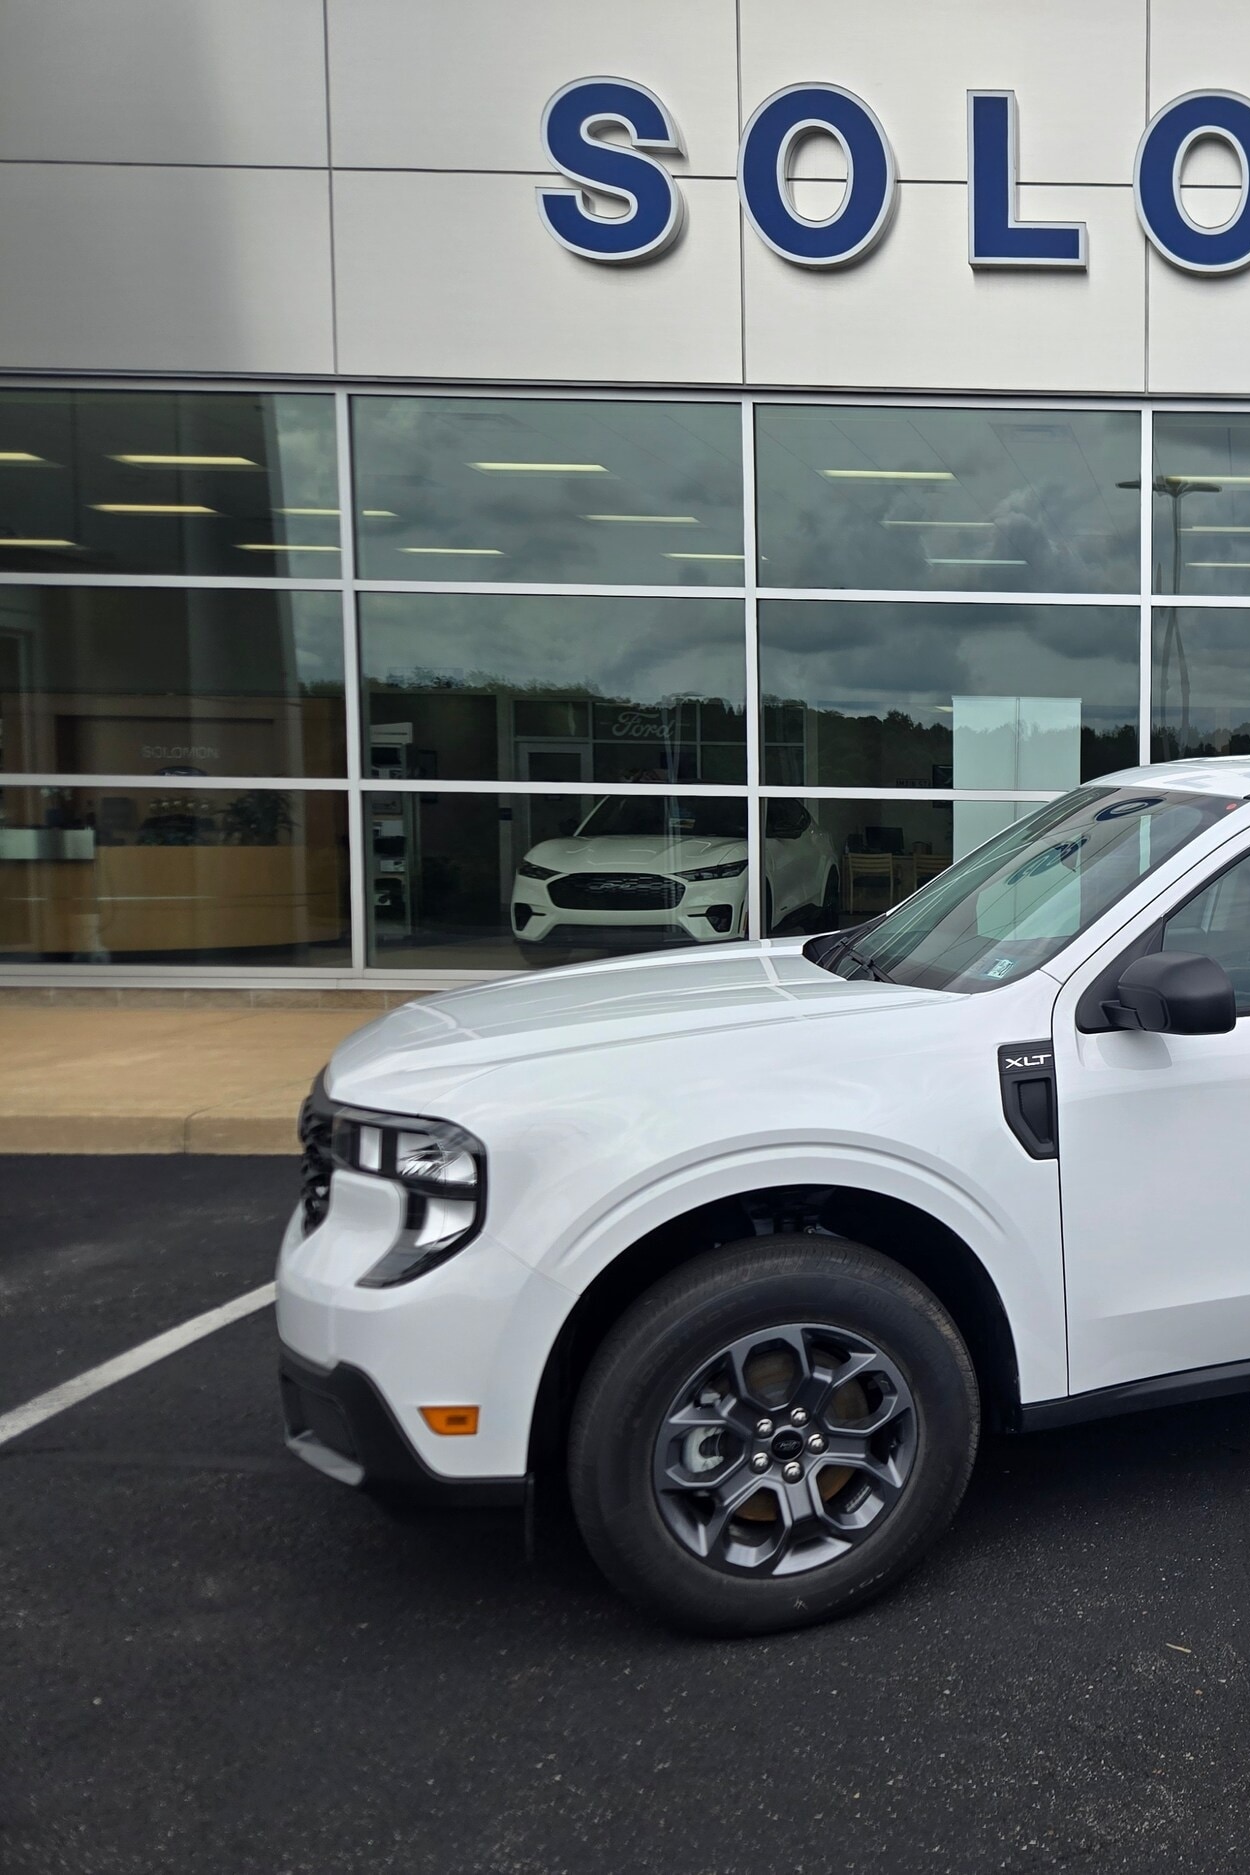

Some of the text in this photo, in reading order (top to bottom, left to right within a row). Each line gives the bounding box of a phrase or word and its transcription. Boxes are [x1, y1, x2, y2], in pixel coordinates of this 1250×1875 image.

[612, 711, 674, 737] Ford
[142, 745, 220, 759] SOLOMON
[1005, 1054, 1052, 1069] XLT
